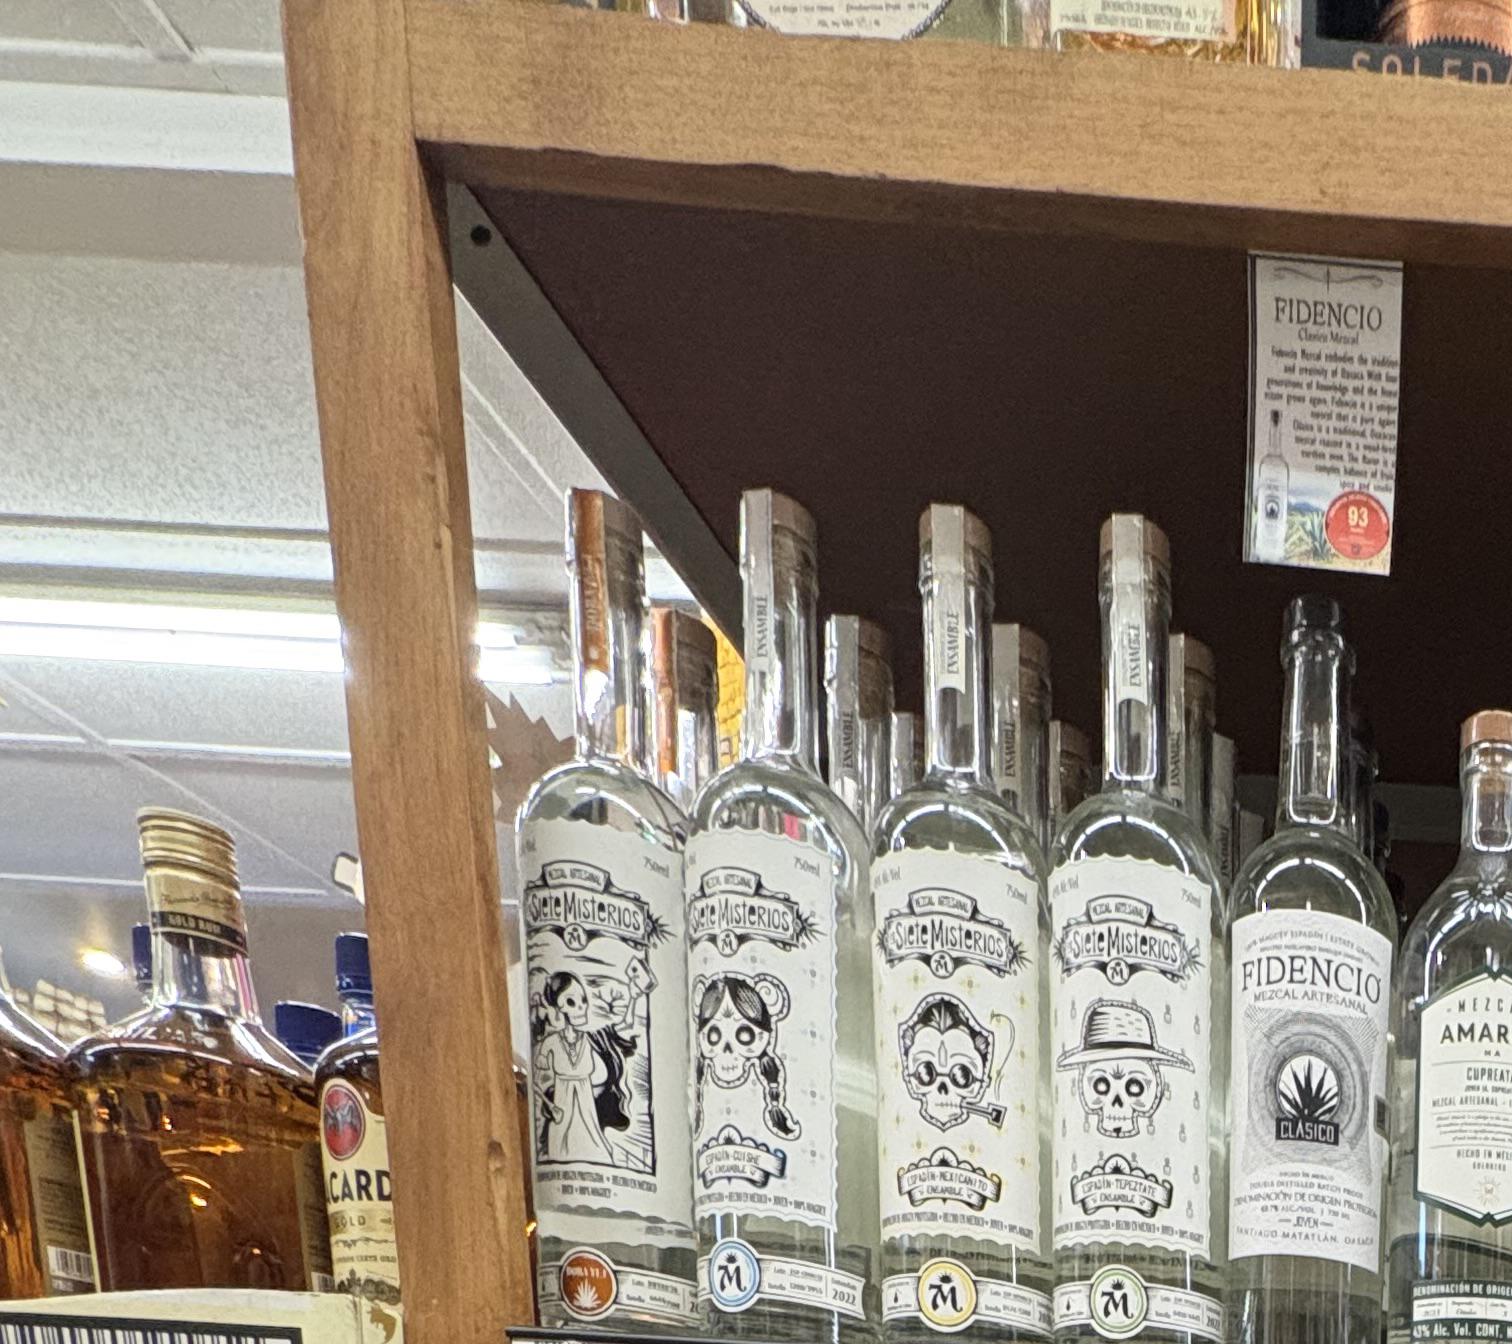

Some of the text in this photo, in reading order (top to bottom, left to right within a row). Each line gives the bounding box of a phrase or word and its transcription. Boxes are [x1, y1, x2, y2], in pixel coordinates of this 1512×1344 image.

[1274, 296, 1382, 332] FIDENCIO
[1348, 505, 1369, 528] 93
[947, 610, 959, 675] ENSAMBLE
[1240, 953, 1382, 1004] FIDENCIO
